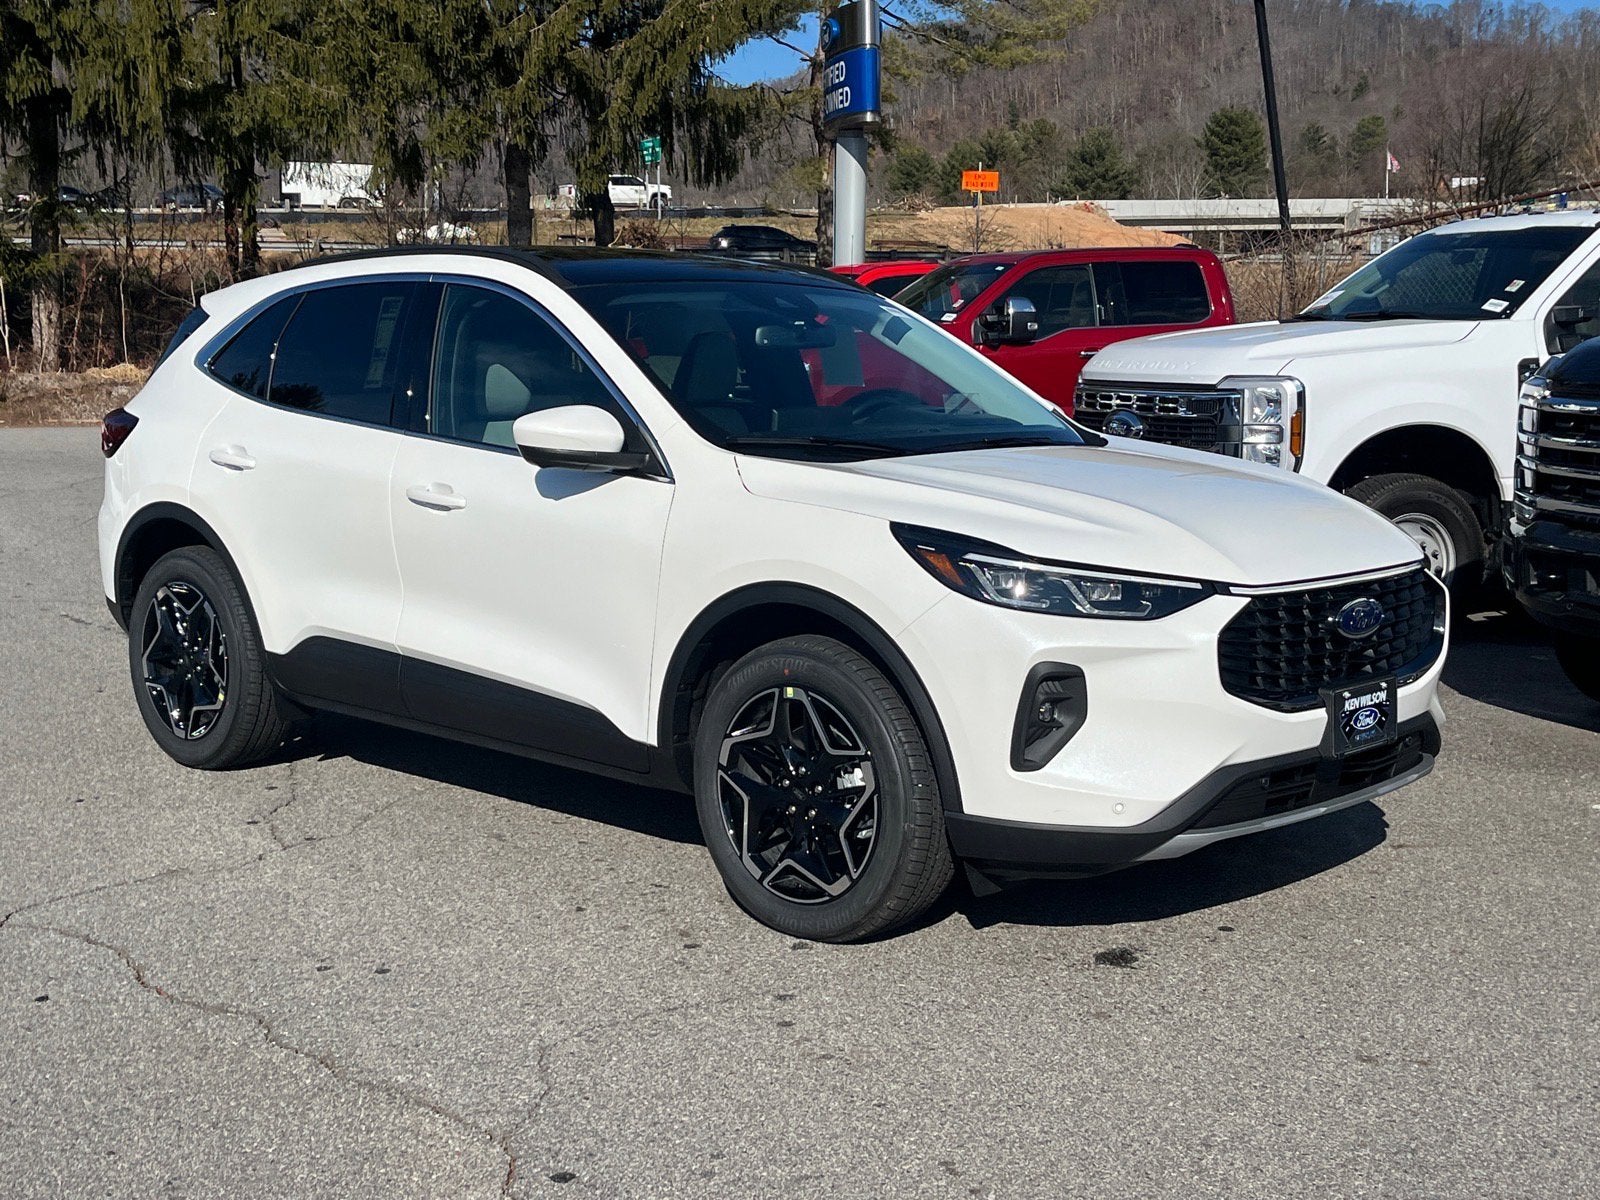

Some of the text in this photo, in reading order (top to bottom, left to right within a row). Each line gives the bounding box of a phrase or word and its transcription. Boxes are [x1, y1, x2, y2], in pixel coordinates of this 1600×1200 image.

[1344, 689, 1388, 712] KEN WILSON
[1356, 710, 1376, 728] Ford
